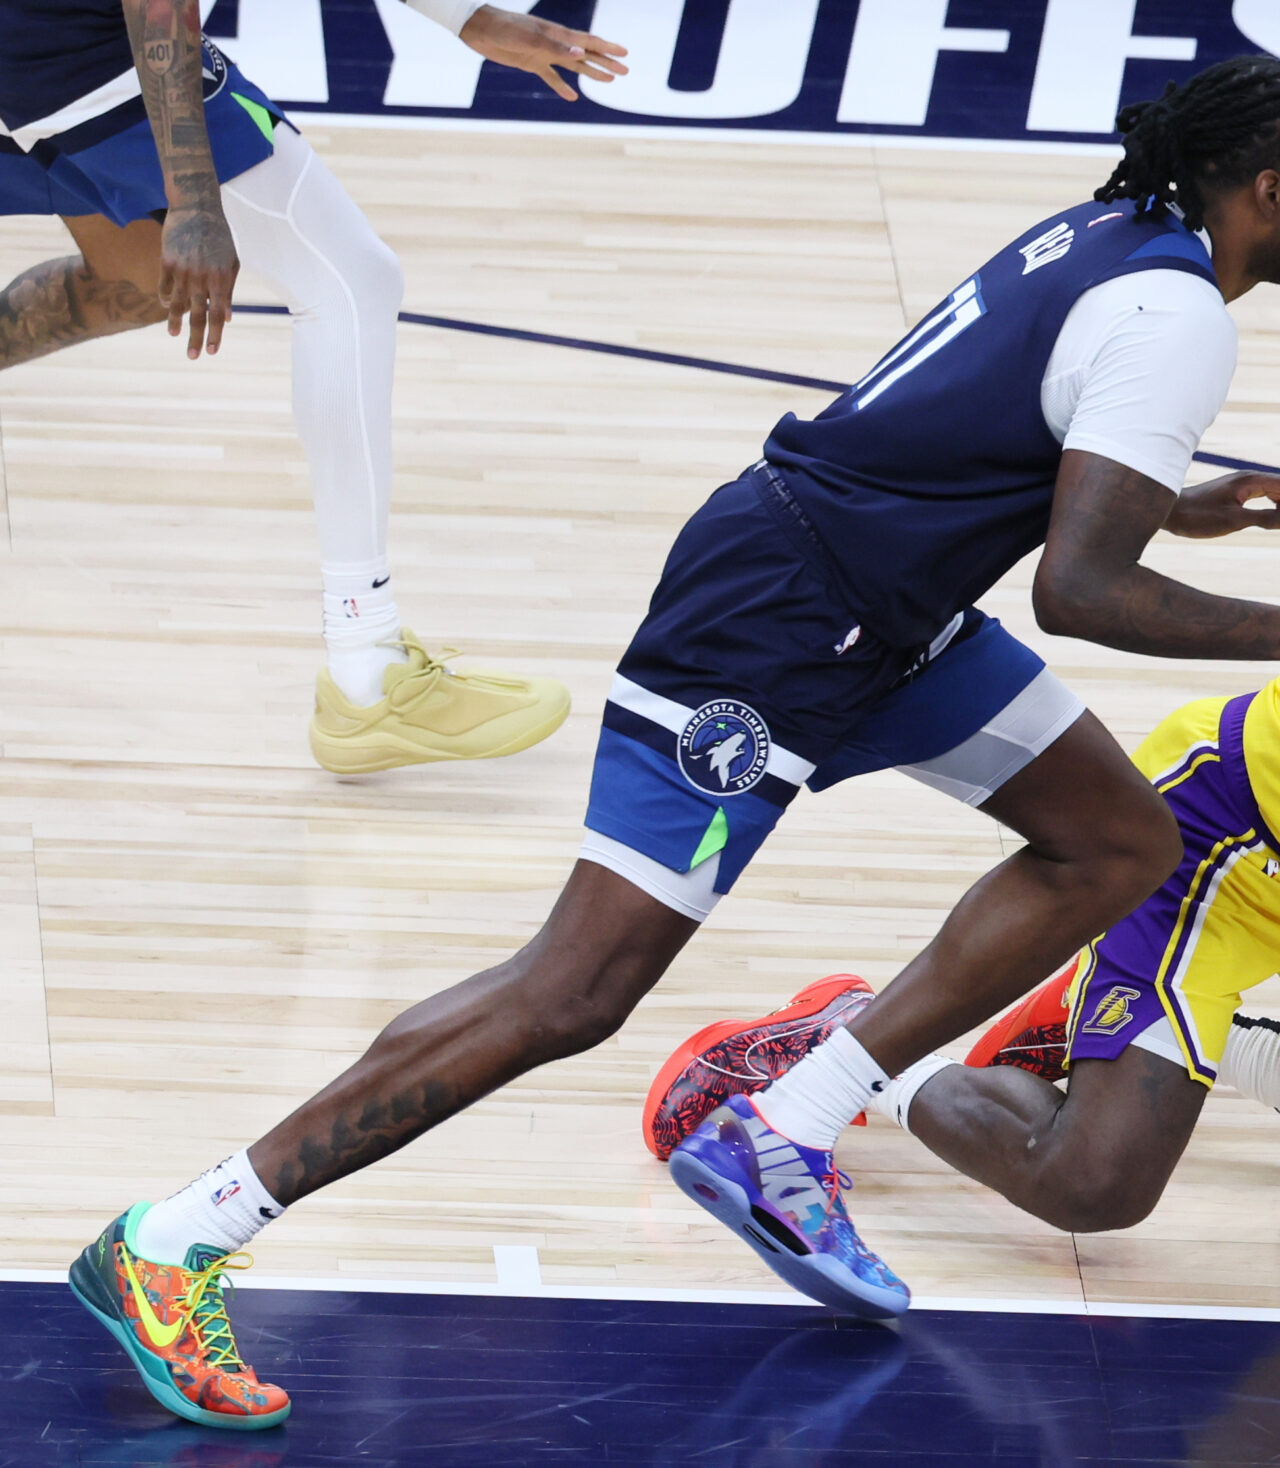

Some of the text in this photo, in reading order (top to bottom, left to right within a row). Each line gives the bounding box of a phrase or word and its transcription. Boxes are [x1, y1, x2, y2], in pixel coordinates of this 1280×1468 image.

[146, 43, 171, 62] 401
[1018, 221, 1075, 276] REID
[852, 272, 987, 412] 11
[681, 703, 768, 788] MINNESOTA TIMBERWOLVES
